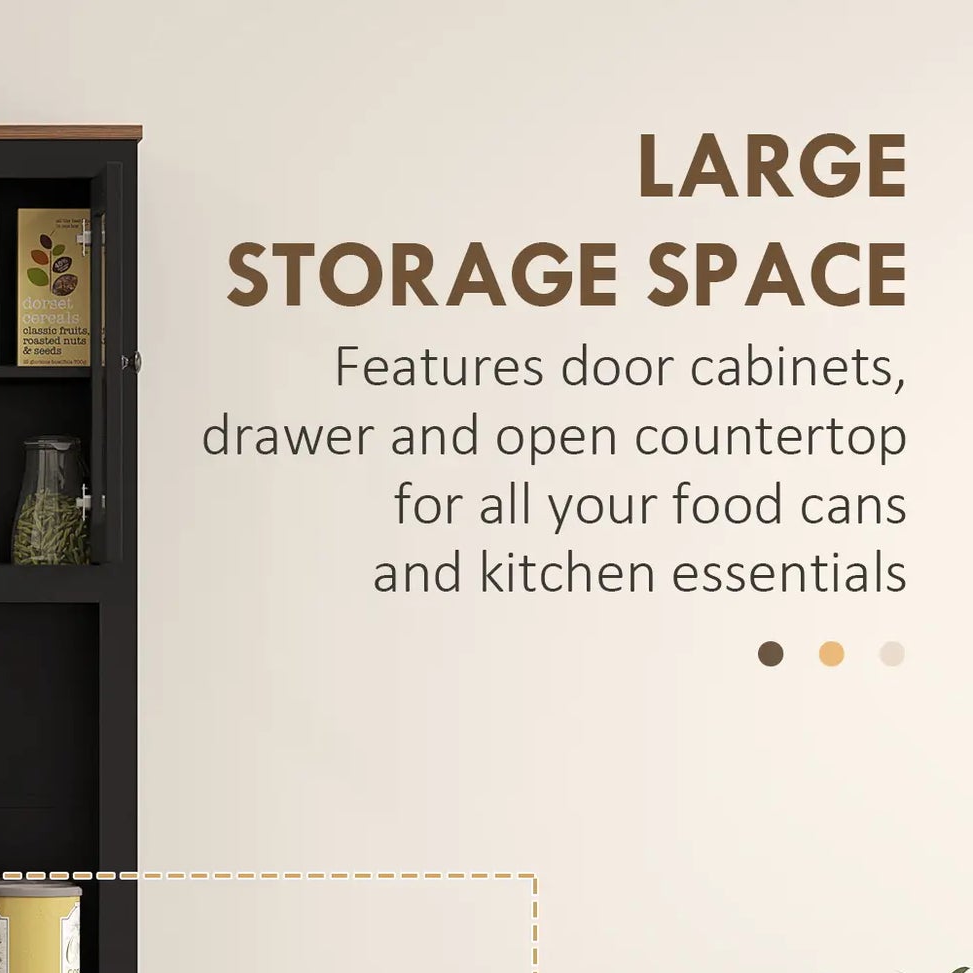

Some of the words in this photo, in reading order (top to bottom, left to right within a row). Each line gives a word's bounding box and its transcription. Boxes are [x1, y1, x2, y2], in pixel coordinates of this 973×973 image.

[23, 296, 74, 310] dorset
[23, 311, 80, 325] cereals
[22, 326, 58, 335] classic
[59, 326, 90, 336] fruits,
[22, 336, 61, 345] roasted
[63, 337, 87, 345] nuts
[22, 346, 32, 355] &
[33, 346, 63, 355] seeds
